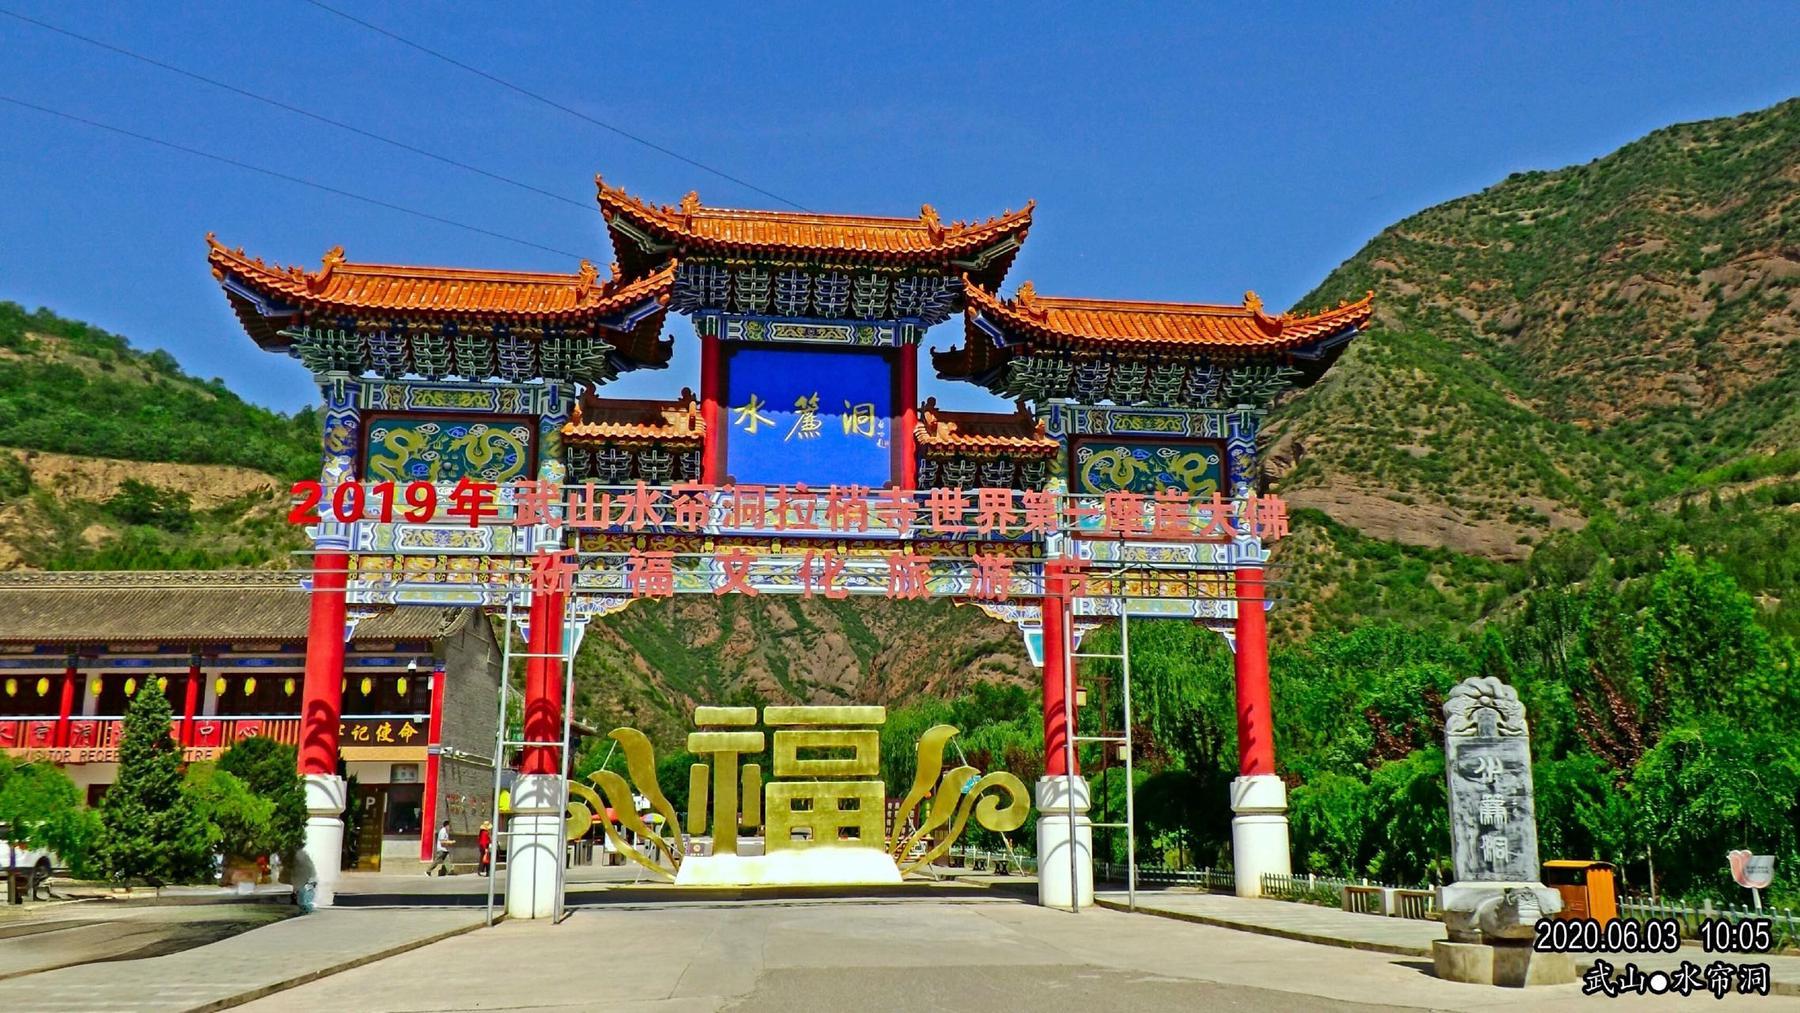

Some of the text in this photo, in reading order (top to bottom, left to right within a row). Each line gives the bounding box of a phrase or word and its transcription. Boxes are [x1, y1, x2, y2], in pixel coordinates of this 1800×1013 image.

[531, 549, 1091, 604] 祈福文化旅游节
[688, 706, 886, 853] 福
